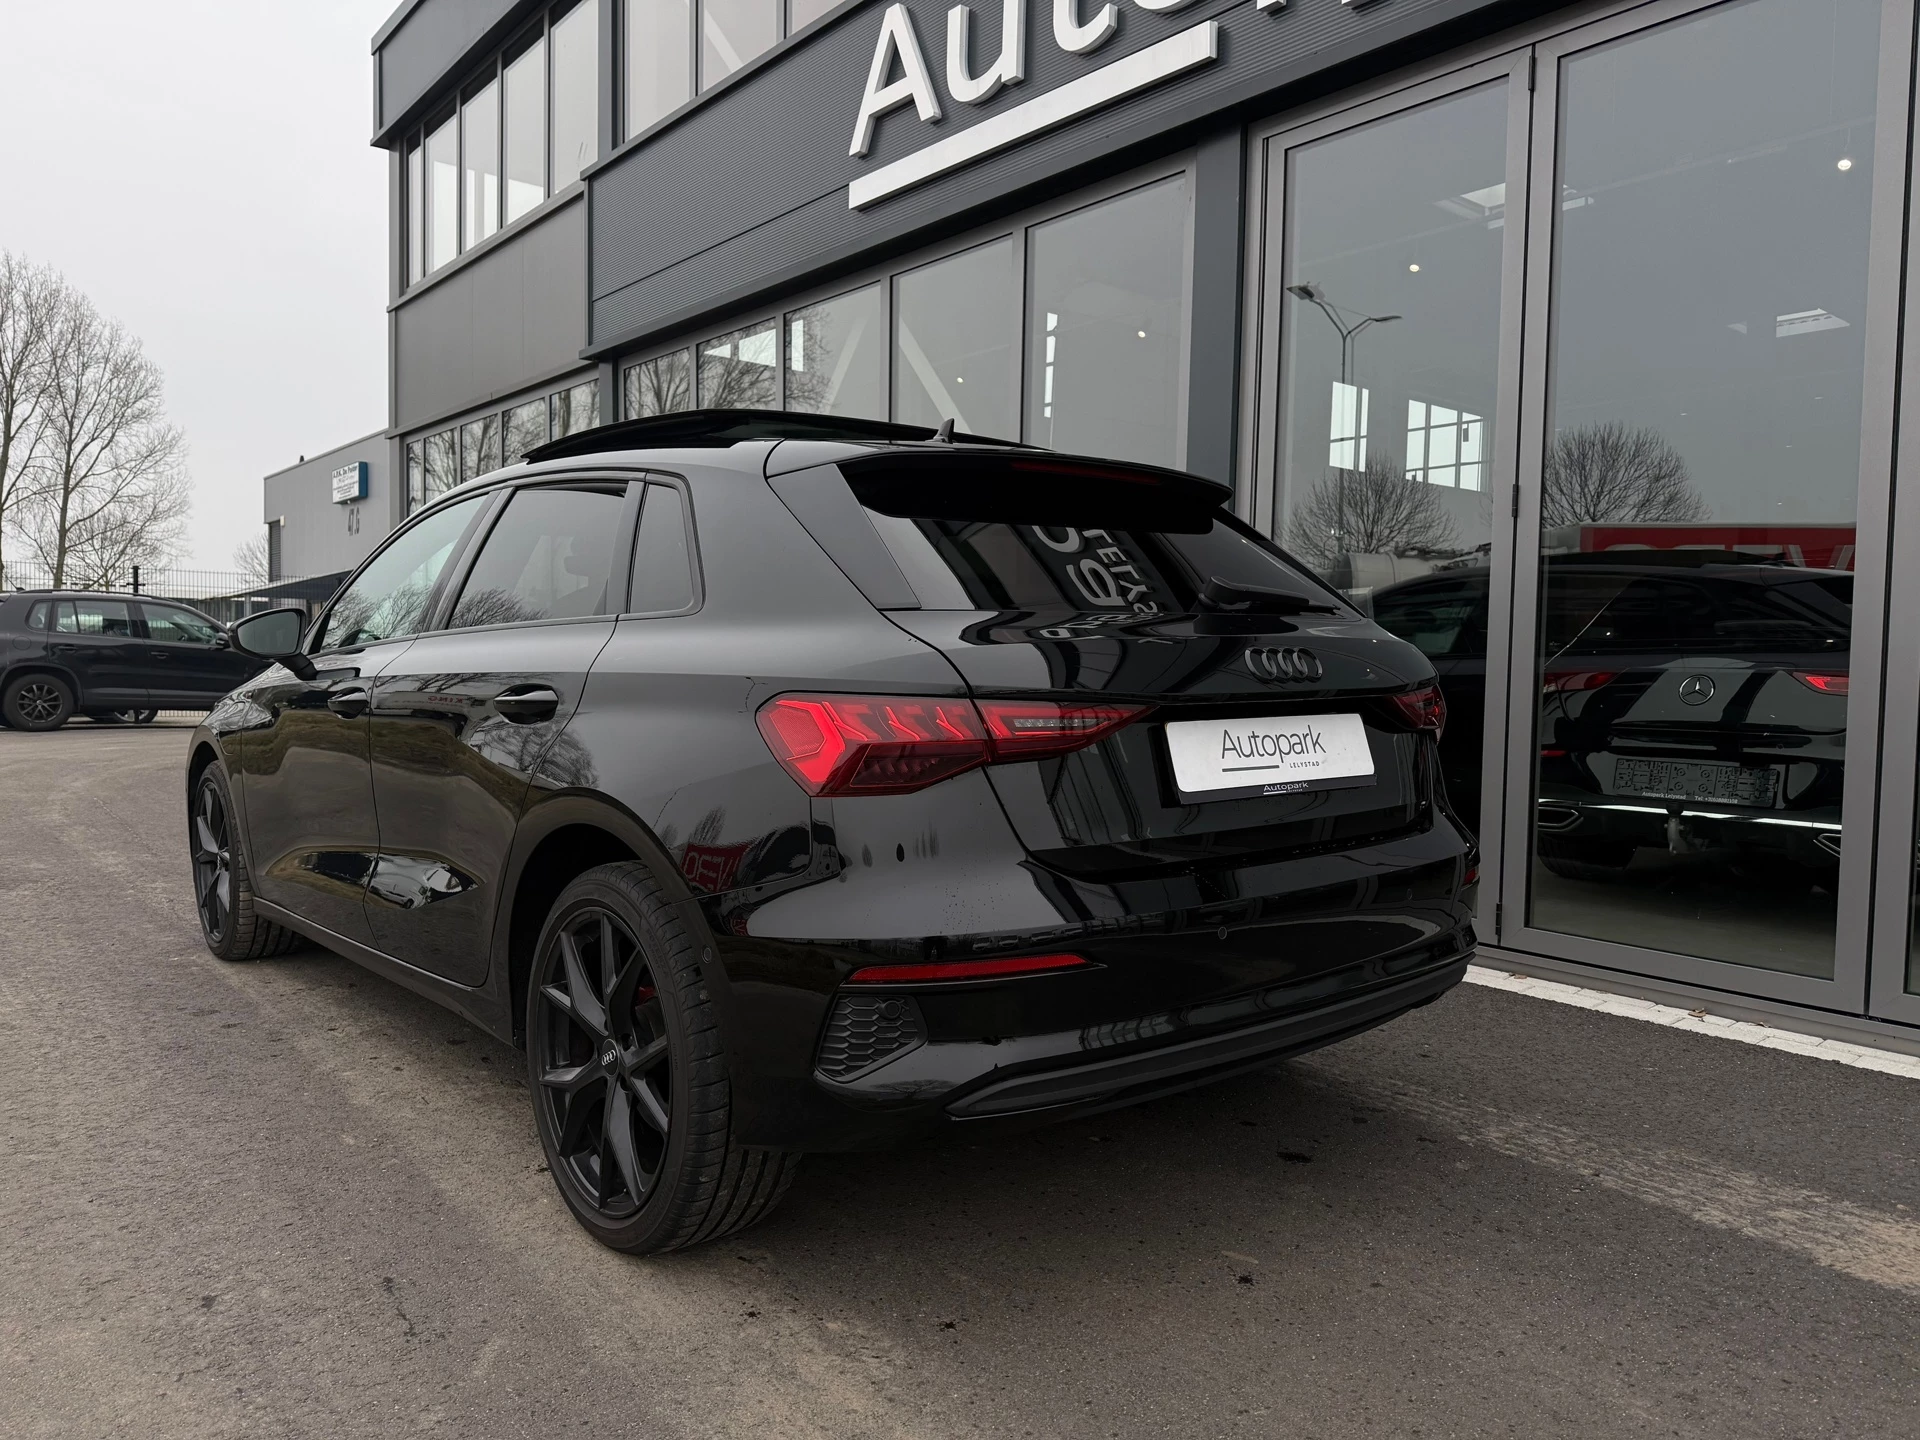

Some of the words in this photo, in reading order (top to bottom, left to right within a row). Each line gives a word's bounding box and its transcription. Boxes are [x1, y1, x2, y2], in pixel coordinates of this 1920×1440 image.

[1221, 724, 1327, 763] Autopark
[1289, 761, 1320, 769] LELYSTAD
[1263, 781, 1309, 792] Autopark
